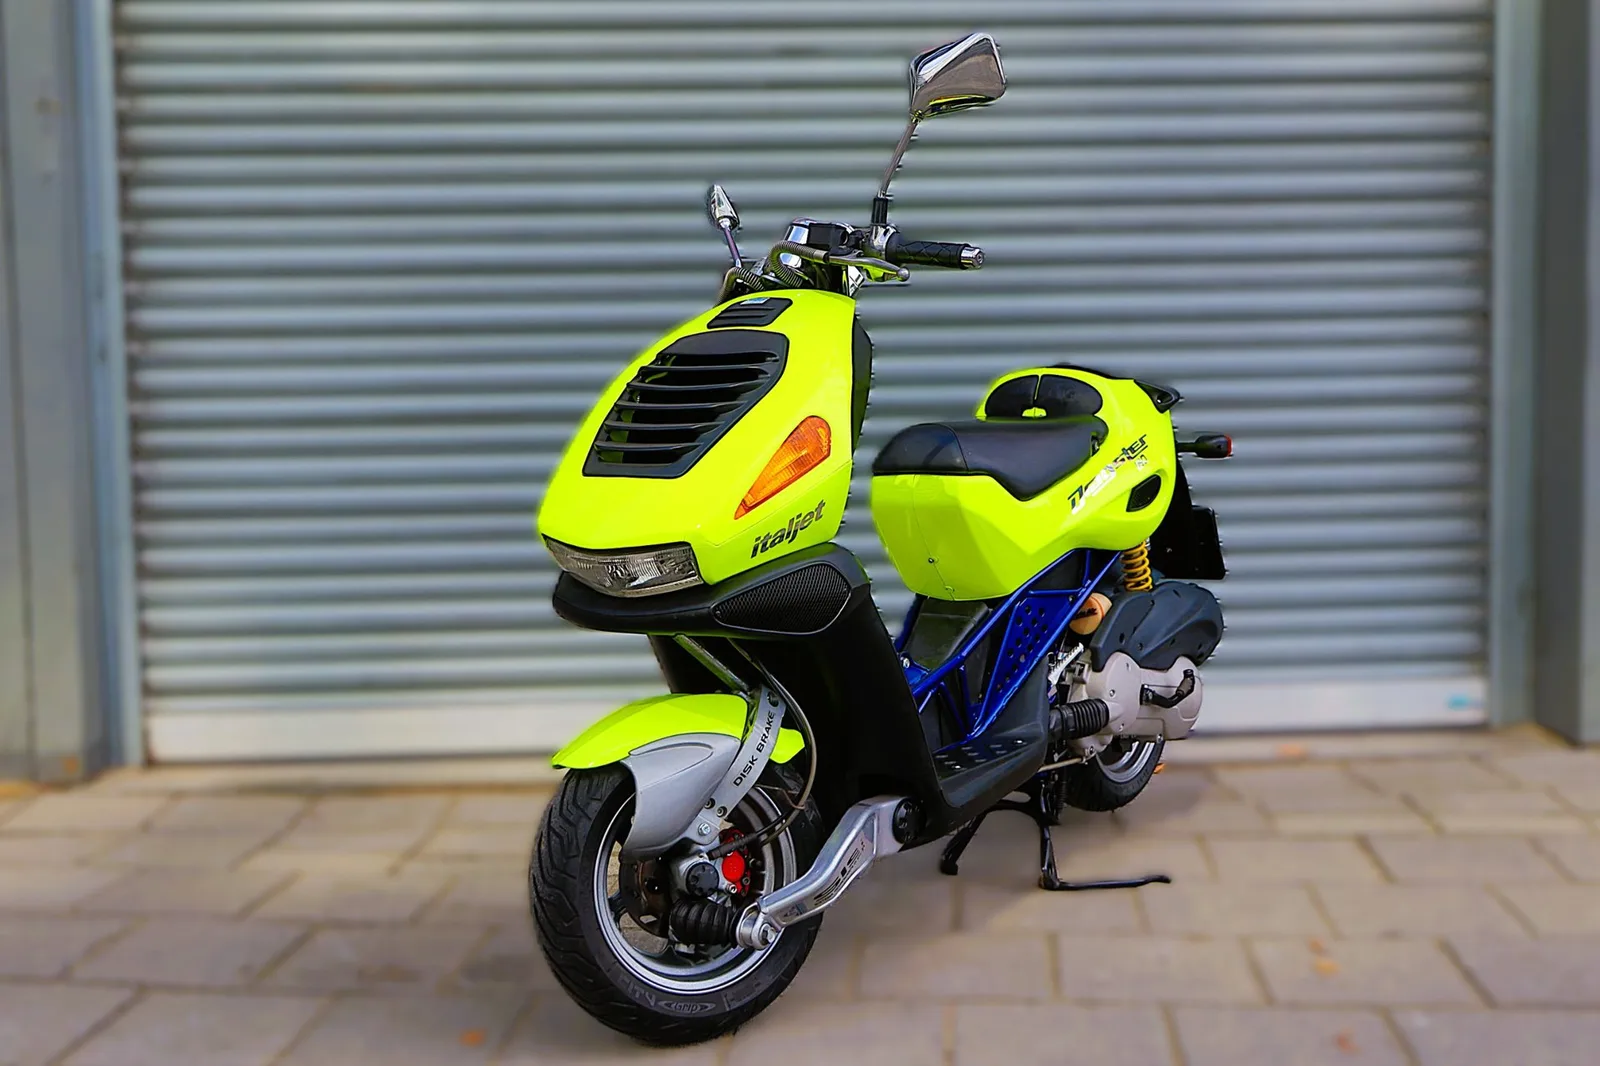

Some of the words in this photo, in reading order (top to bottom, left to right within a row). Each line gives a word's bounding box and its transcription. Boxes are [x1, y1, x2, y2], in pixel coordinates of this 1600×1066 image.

[1067, 434, 1148, 515] Drgster
[751, 500, 826, 558] italjet
[733, 755, 758, 787] DISK
[756, 711, 776, 753] BRAKE
